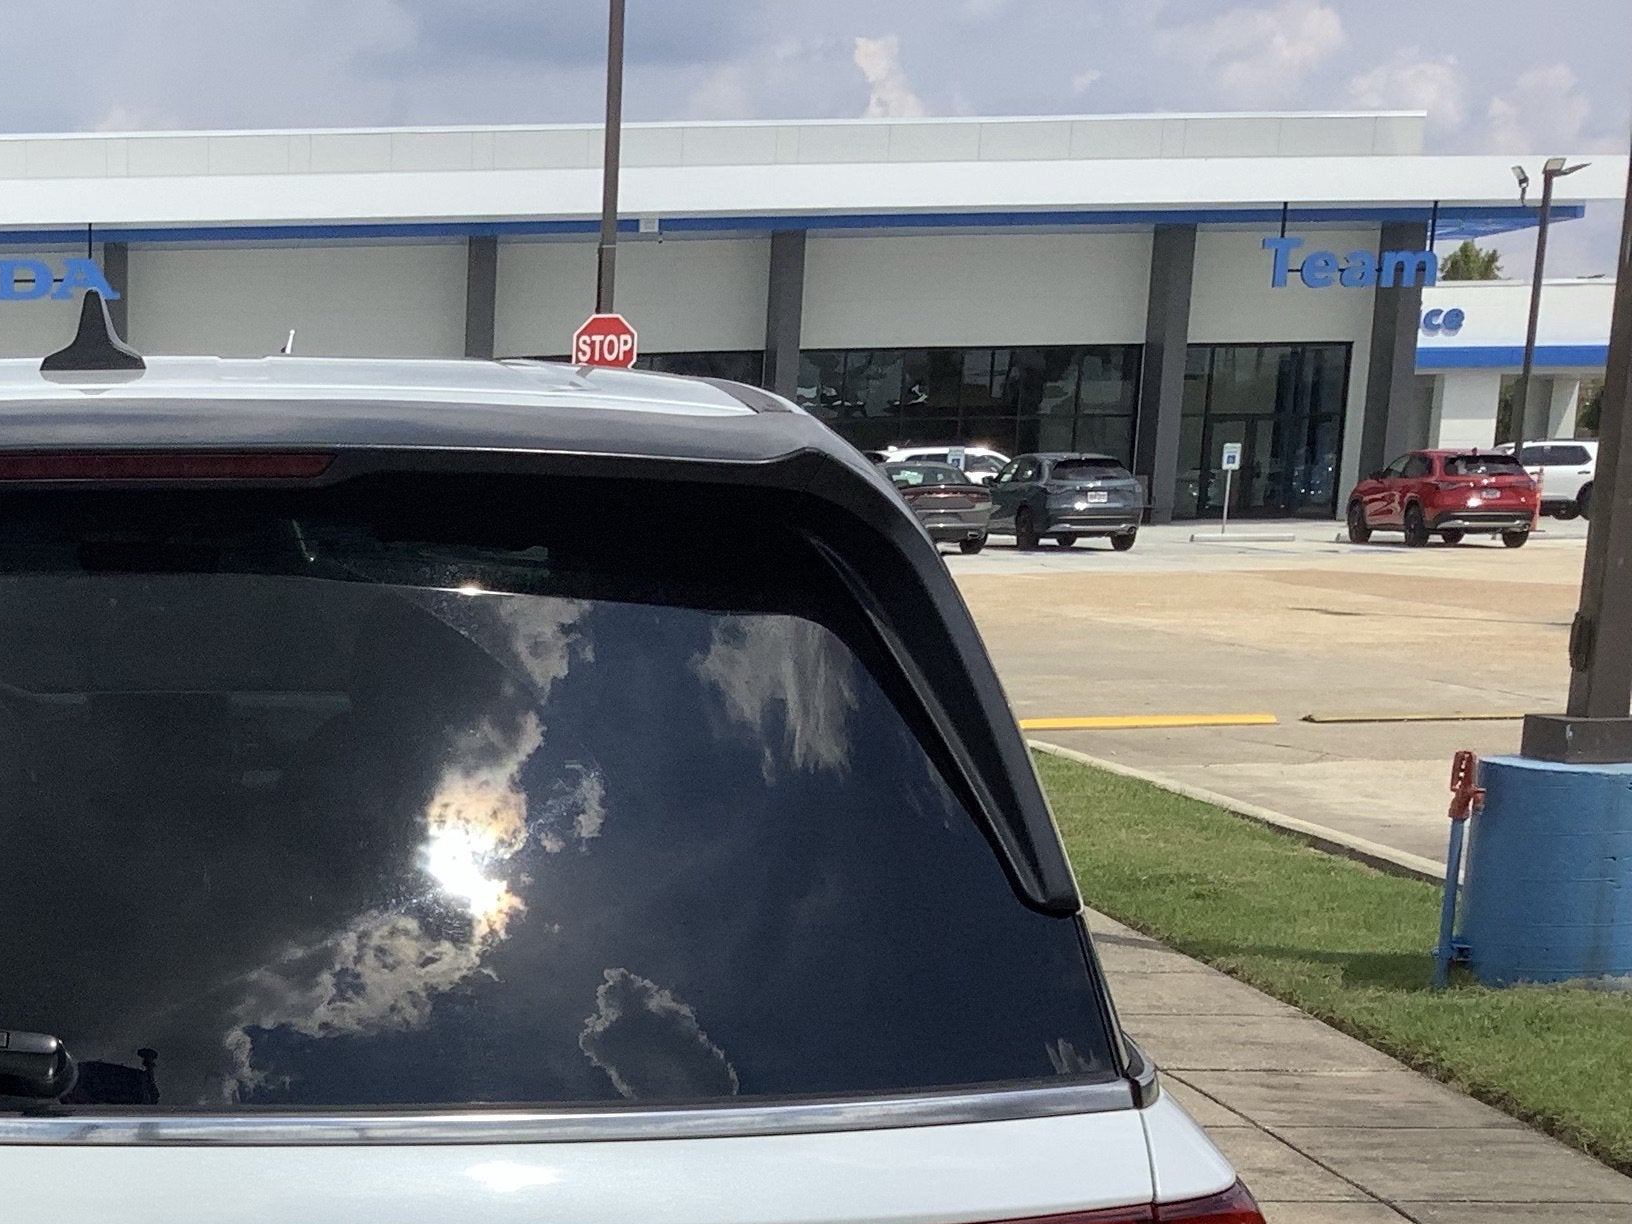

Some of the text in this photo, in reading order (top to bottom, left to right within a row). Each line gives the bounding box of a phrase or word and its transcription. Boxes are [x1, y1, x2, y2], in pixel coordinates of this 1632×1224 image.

[1262, 237, 1437, 289] Team
[1419, 308, 1465, 332] ce
[577, 334, 632, 362] STOP
